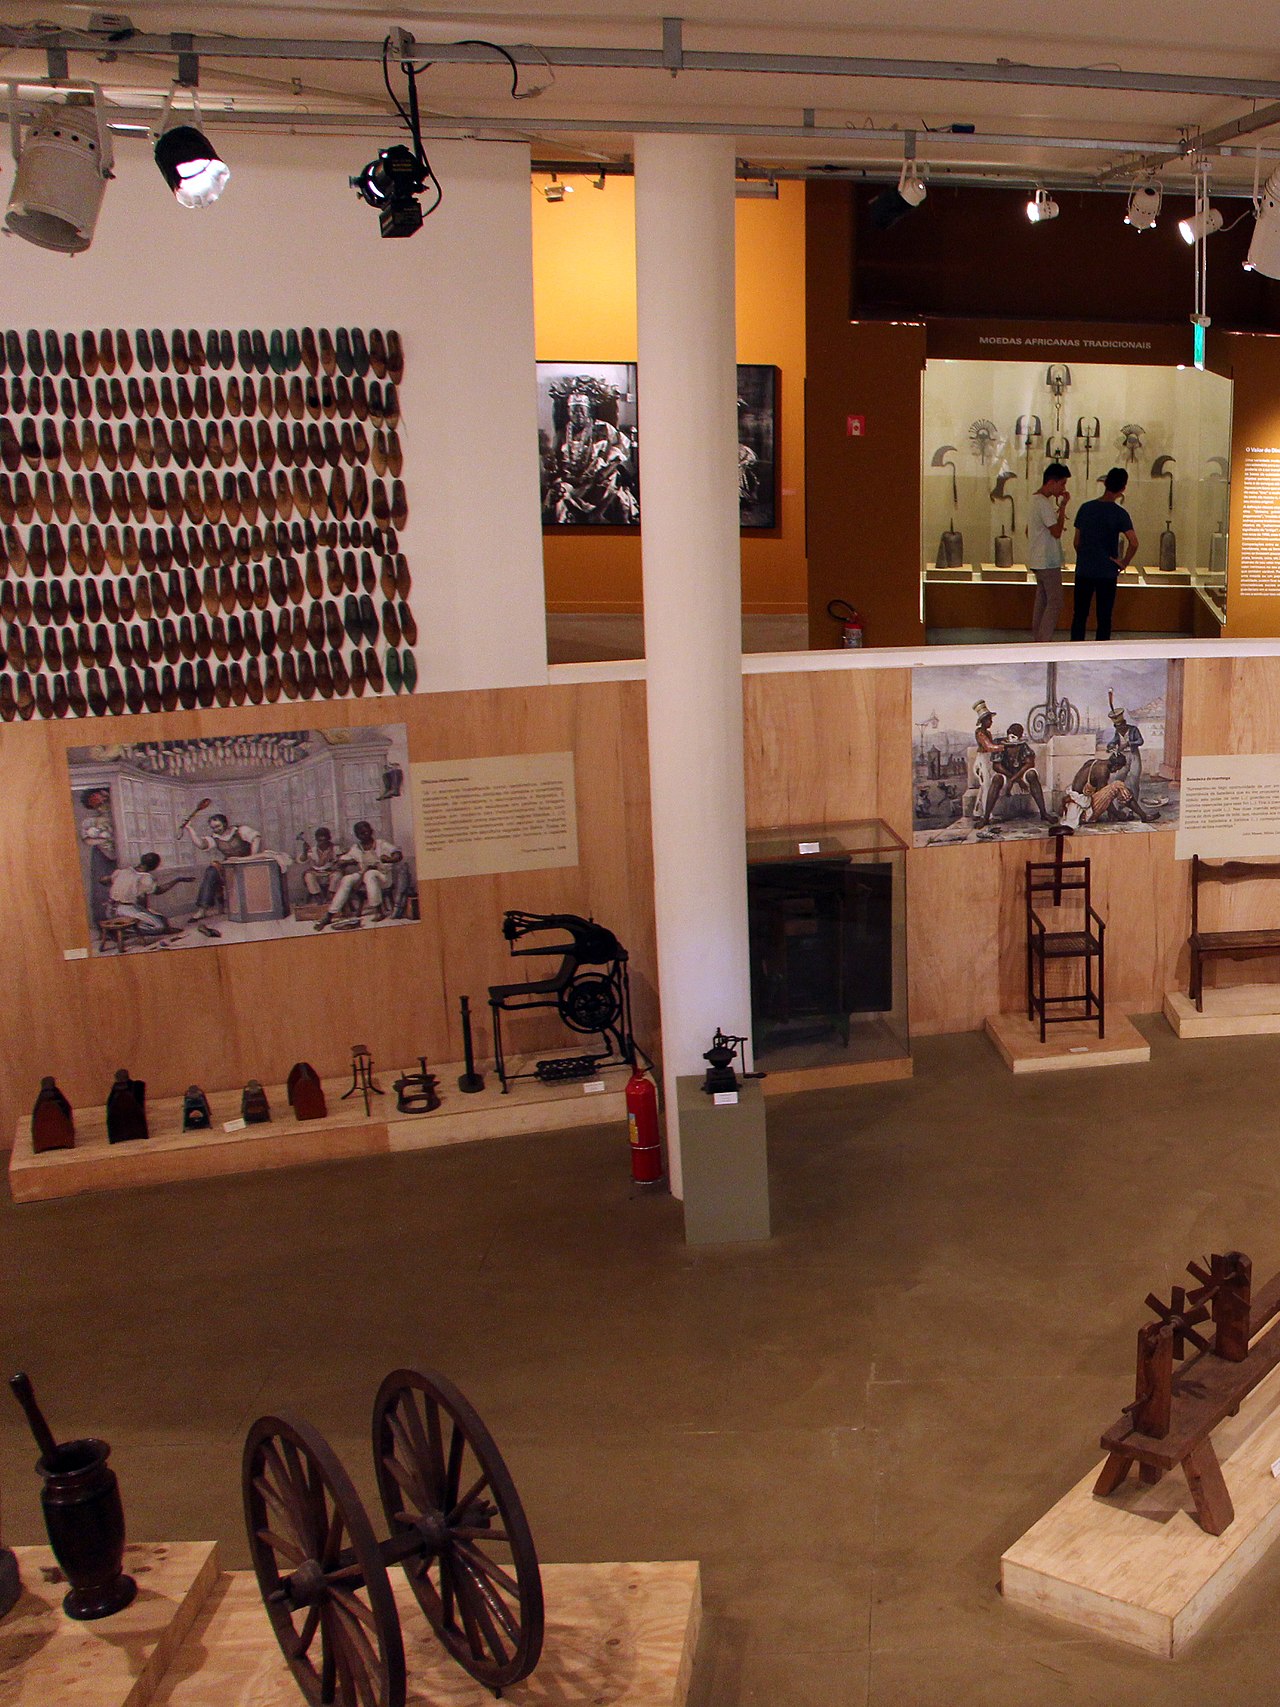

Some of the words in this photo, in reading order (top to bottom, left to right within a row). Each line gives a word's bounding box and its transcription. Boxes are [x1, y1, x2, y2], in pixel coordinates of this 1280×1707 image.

[979, 336, 1022, 345] MOEDAS
[1024, 338, 1080, 347] AFRICANAS
[1083, 340, 1152, 349] TRADICIONAIS
